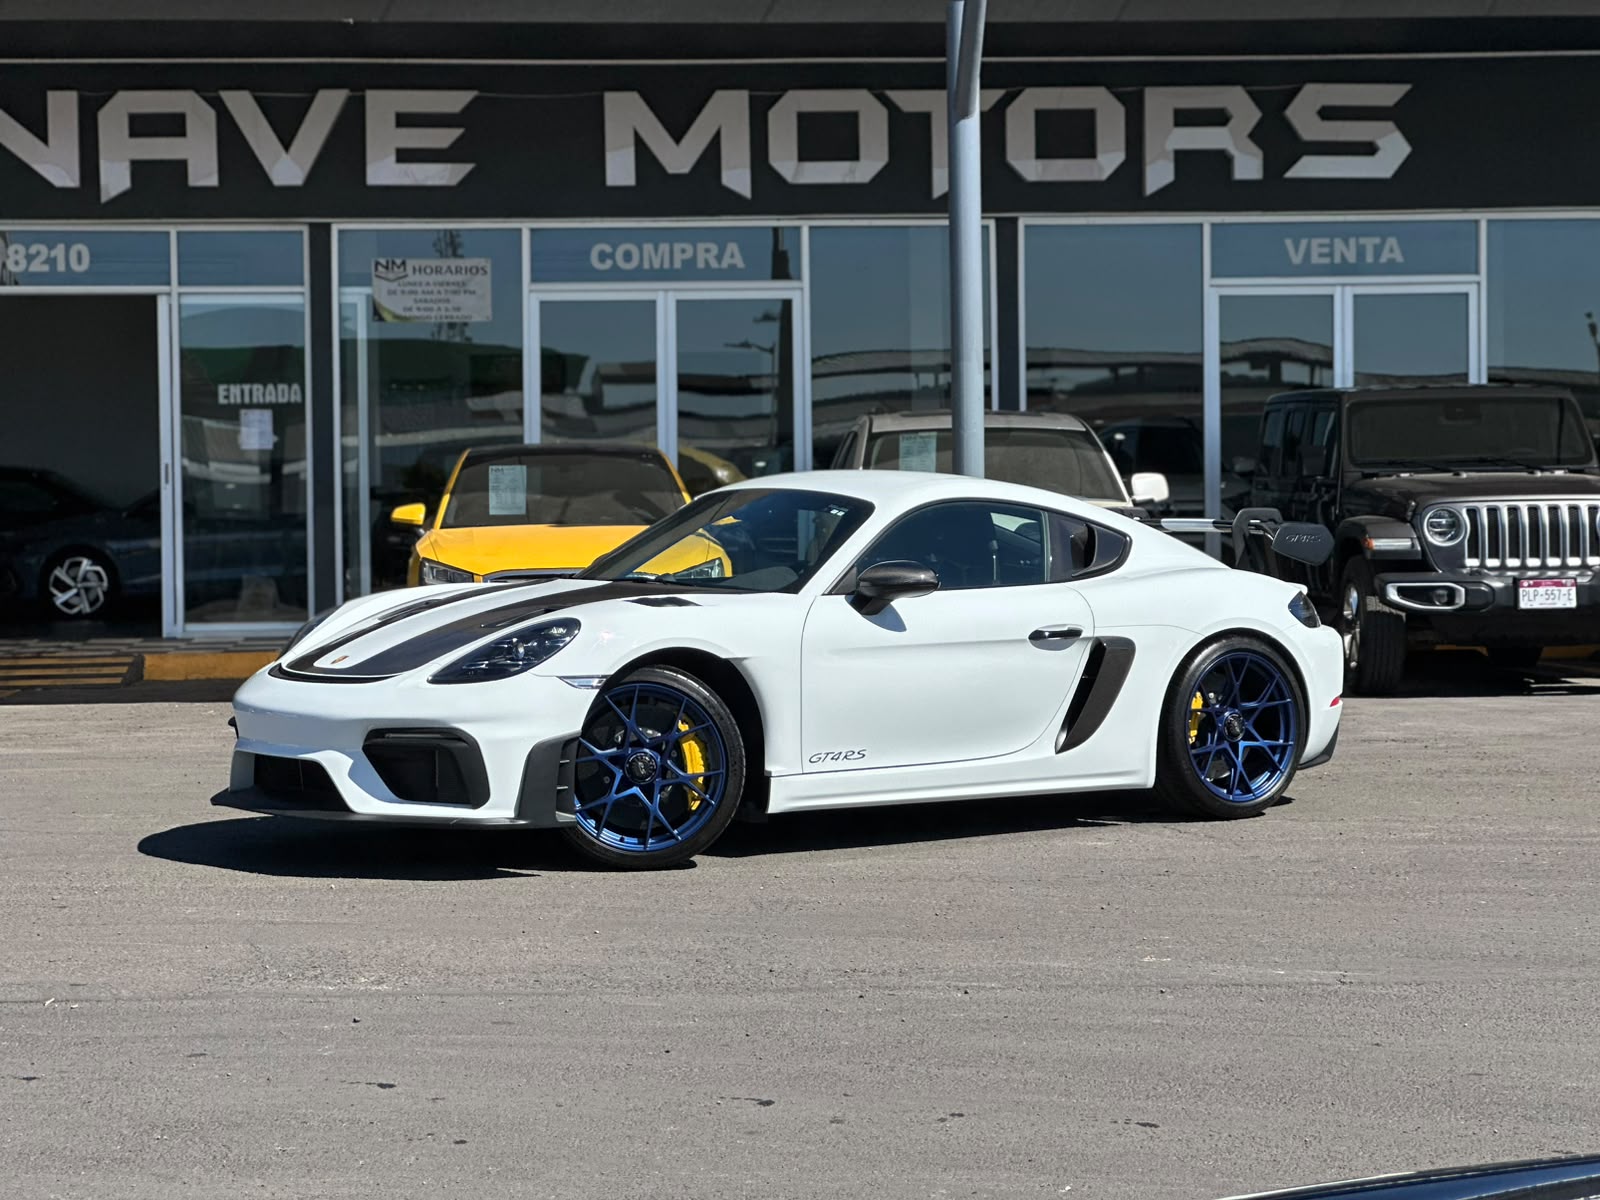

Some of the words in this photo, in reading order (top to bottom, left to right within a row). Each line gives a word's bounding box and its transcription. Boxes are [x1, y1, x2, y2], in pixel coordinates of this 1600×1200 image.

[0, 89, 478, 203] NAVE
[603, 83, 1413, 199] MOTORS
[6, 243, 90, 273] 8210
[590, 242, 745, 271] COMPRA
[1284, 237, 1404, 265] VENTA
[375, 259, 407, 272] NM
[412, 265, 488, 276] HORARIOS
[217, 382, 303, 405] ENTRADA
[1522, 589, 1573, 602] PLP-557-E
